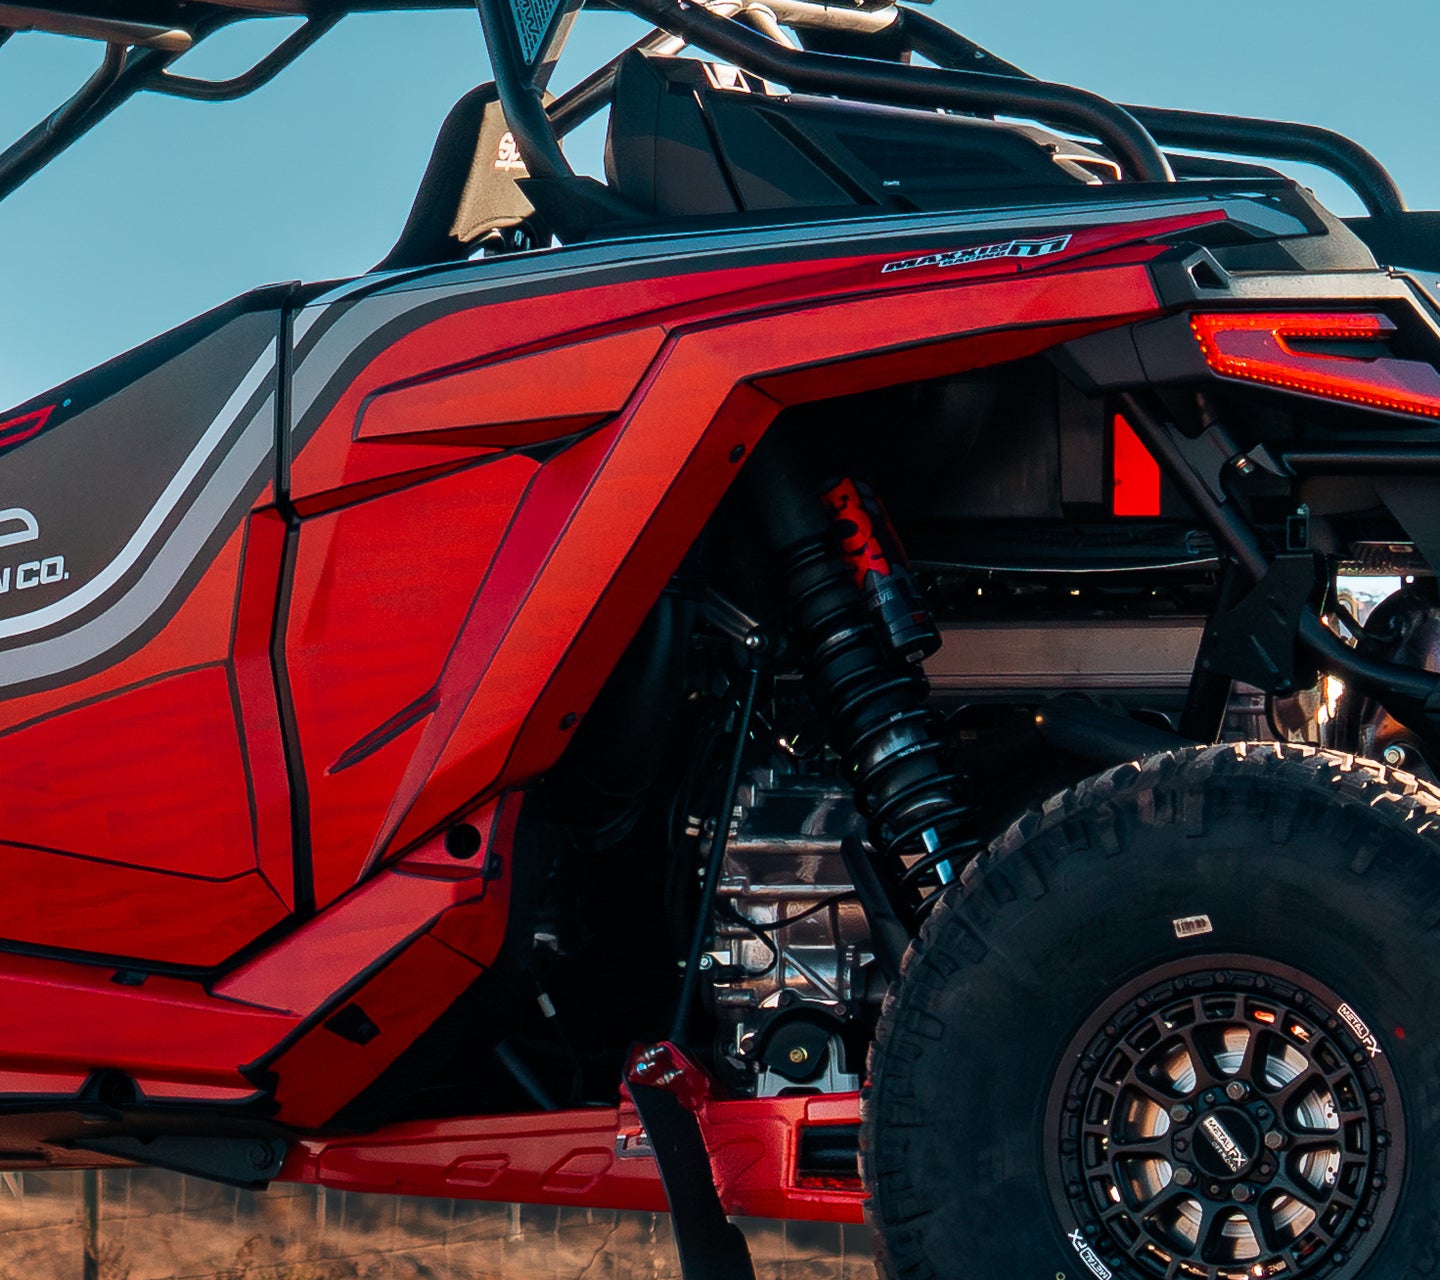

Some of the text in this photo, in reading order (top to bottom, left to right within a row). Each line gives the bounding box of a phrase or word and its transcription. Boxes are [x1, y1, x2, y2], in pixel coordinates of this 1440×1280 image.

[882, 243, 1009, 272] MAXXIS
[939, 252, 1006, 267] RACING
[15, 555, 70, 591] CO.
[1339, 1005, 1367, 1037] METAL
[1205, 1118, 1233, 1151] METAL
[1082, 1249, 1110, 1280] METAL
